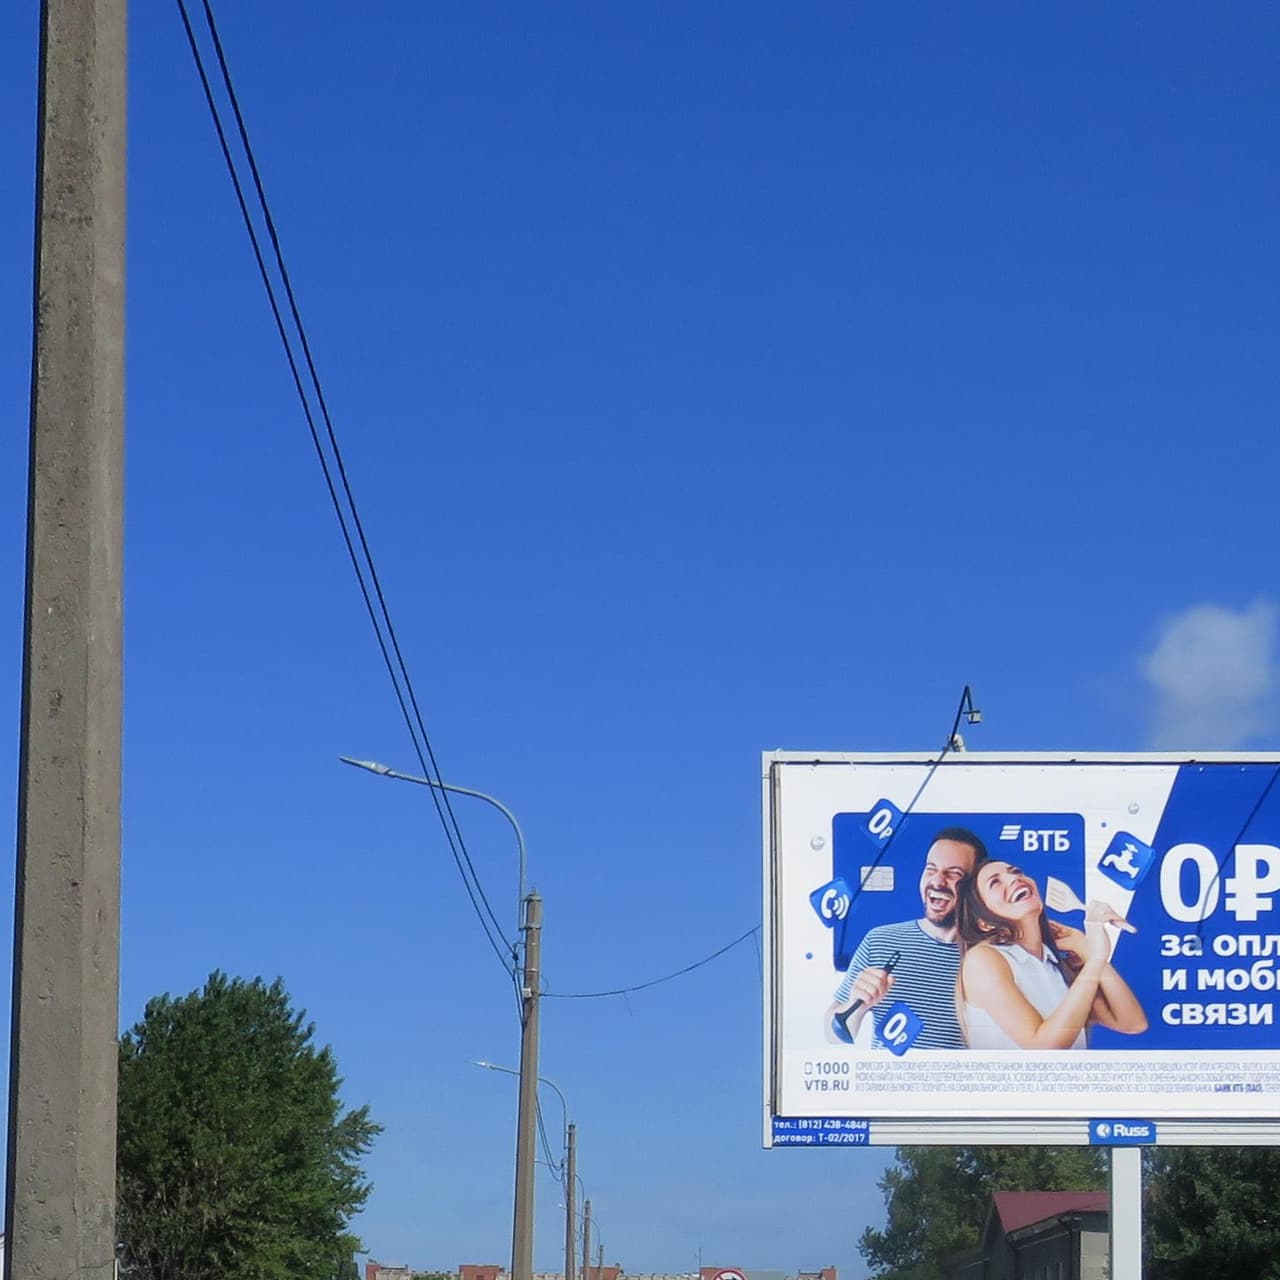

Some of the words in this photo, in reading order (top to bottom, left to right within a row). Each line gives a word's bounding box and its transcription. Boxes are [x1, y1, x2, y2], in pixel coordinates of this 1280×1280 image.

[1023, 829, 1071, 852] ВТБ
[1160, 934, 1203, 957] за
[1161, 968, 1187, 991] и
[1161, 1002, 1274, 1026] связи
[816, 1062, 850, 1075] 1000
[804, 1079, 850, 1092] VTB.RU
[774, 1134, 816, 1144] договор:
[1113, 1123, 1150, 1137] Russ
